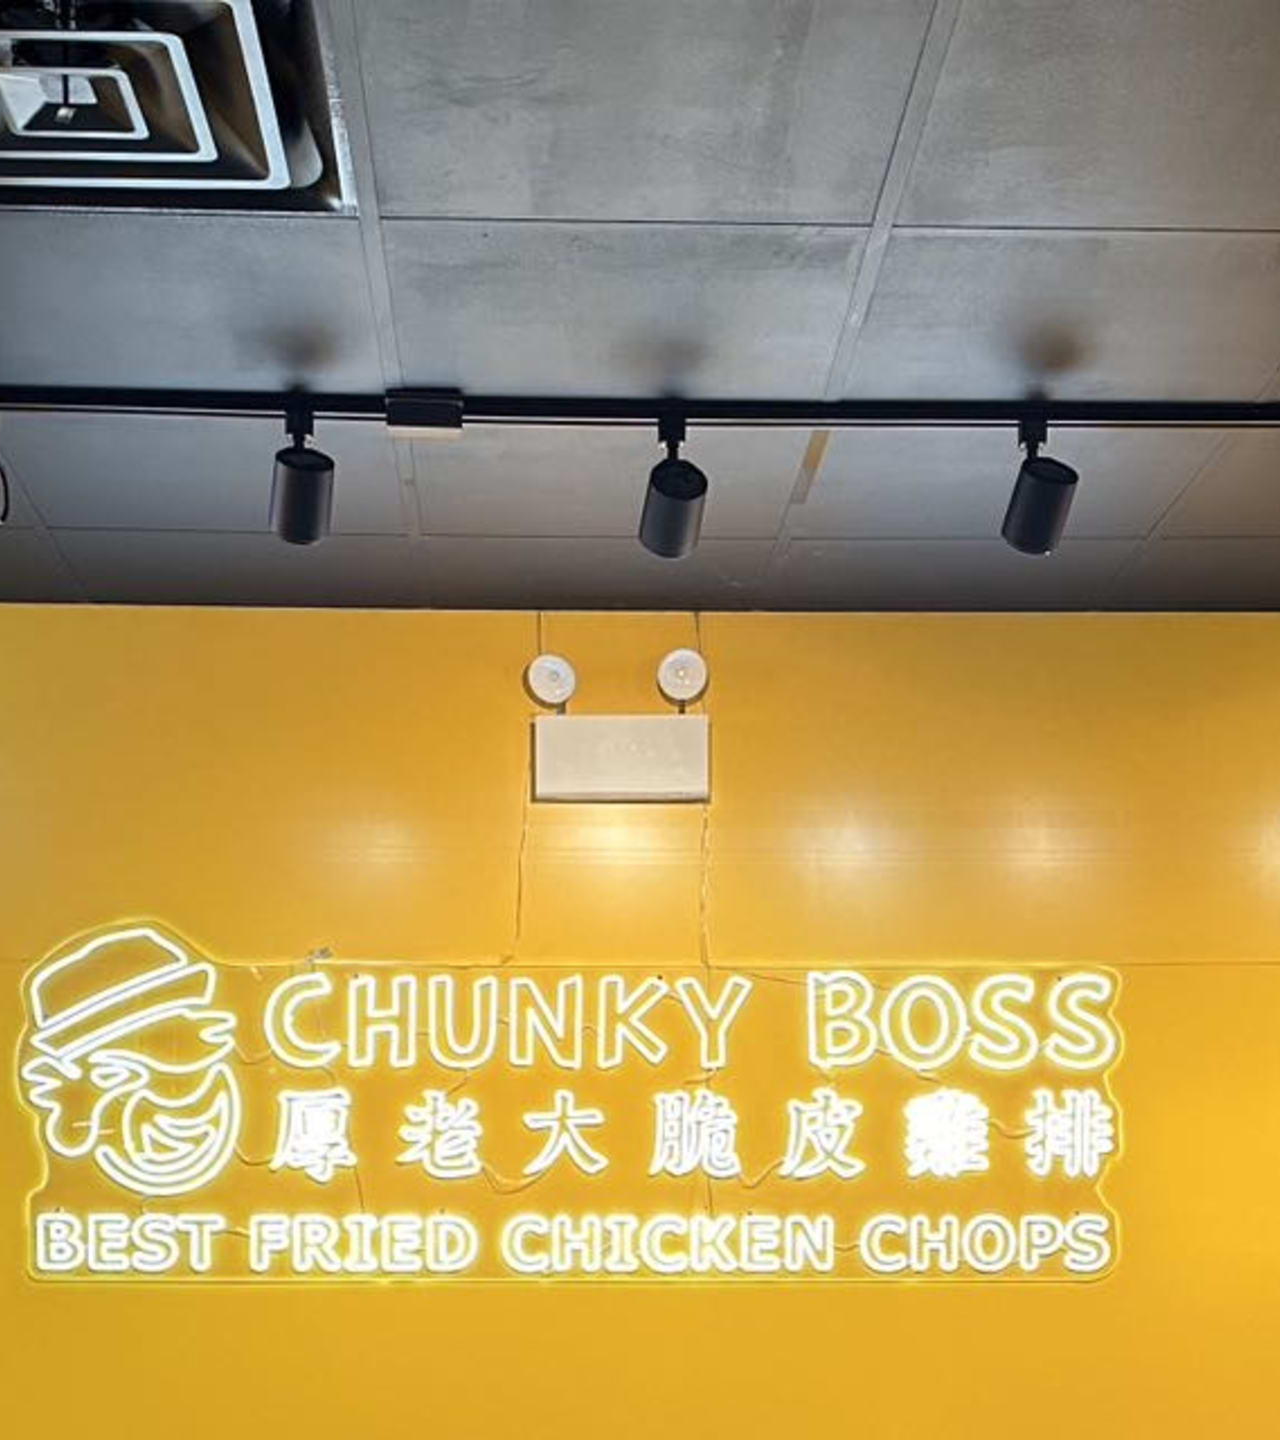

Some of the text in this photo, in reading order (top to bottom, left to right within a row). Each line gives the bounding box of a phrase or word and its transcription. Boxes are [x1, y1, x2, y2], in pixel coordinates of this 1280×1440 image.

[263, 971, 1117, 1071] CHUNKY BOSS
[35, 1211, 1112, 1275] BEST FRIED CHICKEN CHOPS
